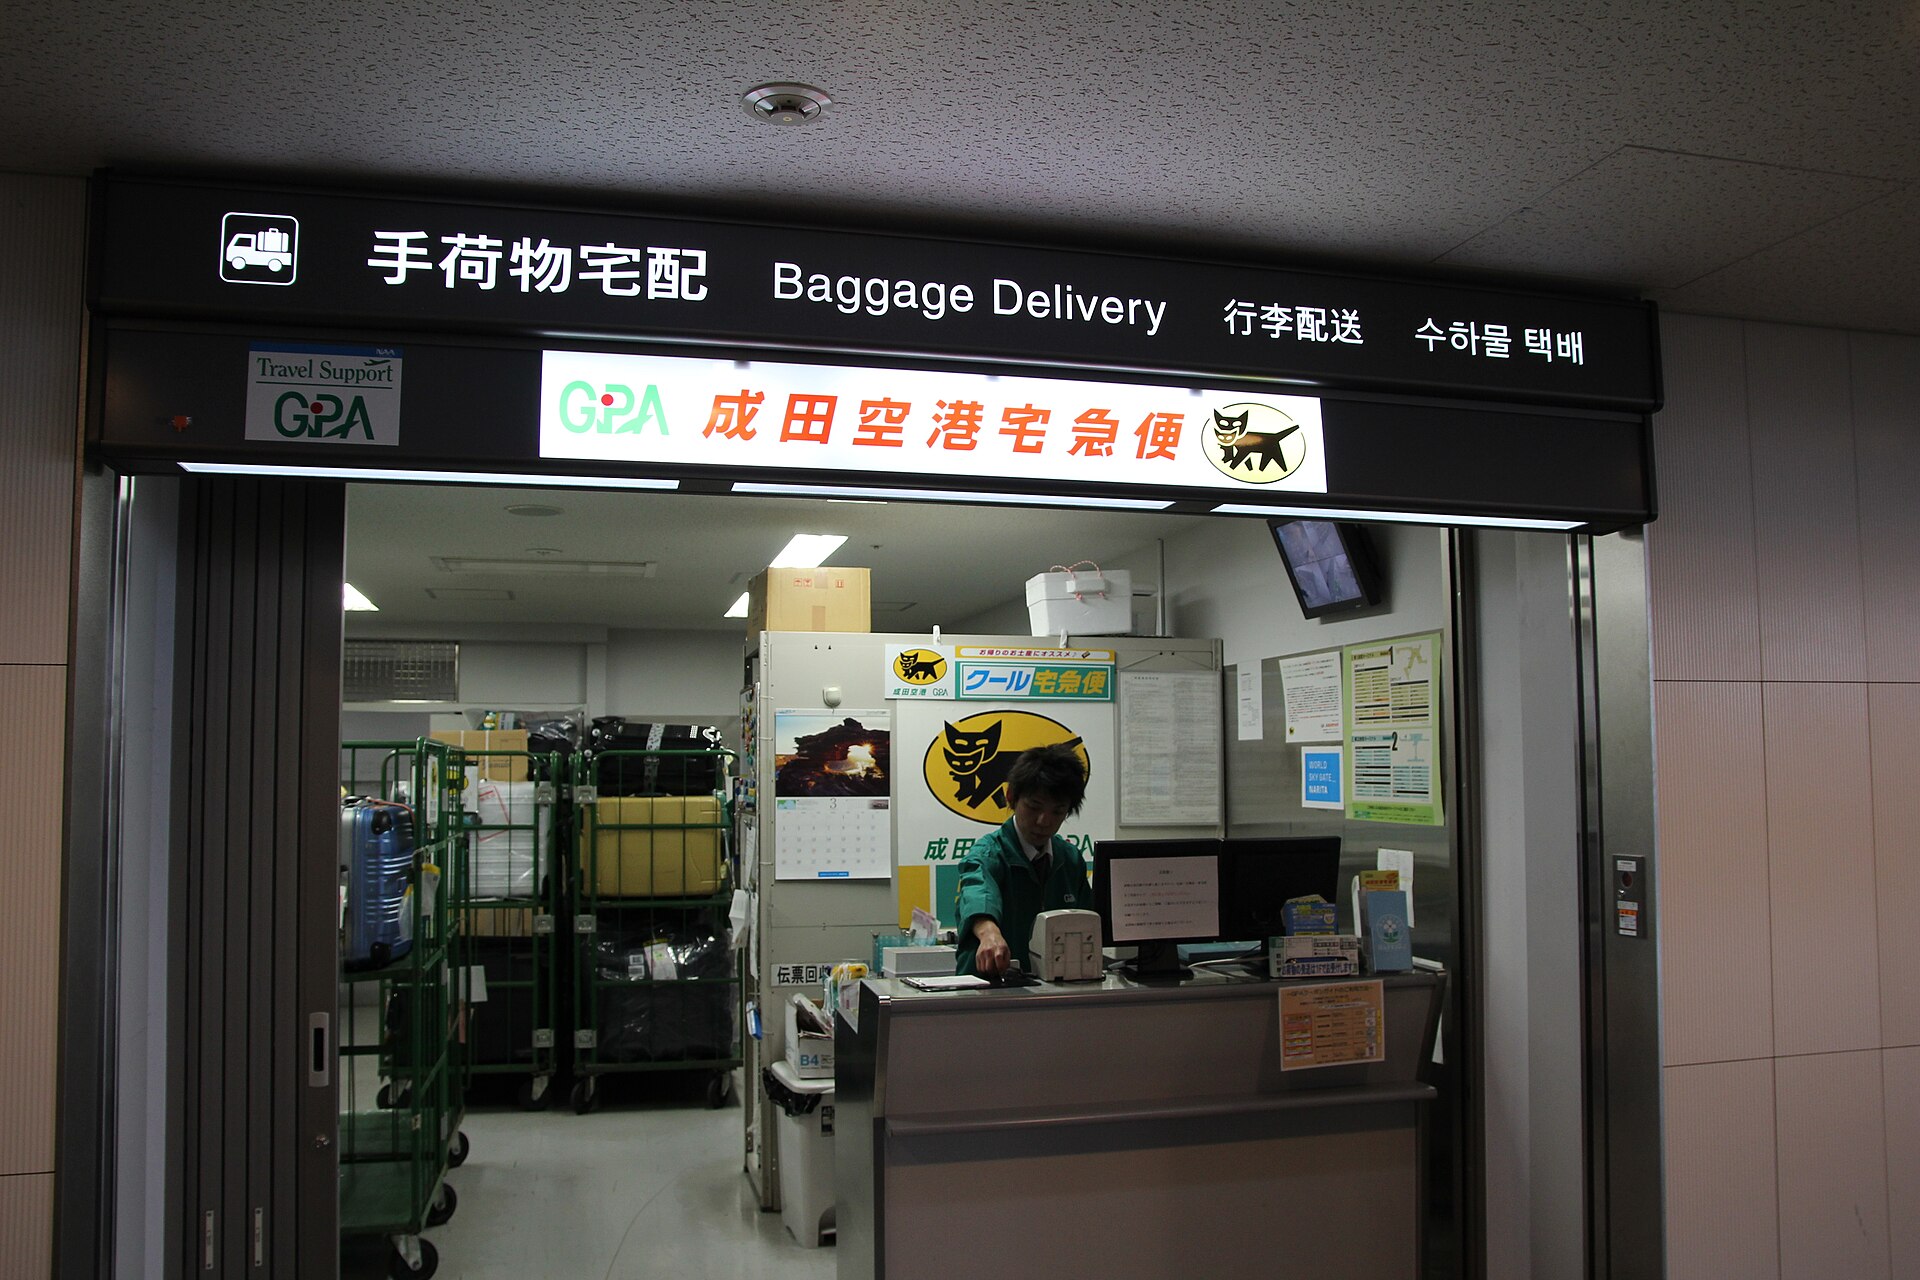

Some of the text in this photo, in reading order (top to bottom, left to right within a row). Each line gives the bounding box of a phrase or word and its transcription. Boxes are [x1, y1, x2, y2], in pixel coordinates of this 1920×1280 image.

[368, 230, 708, 301] 手荷物宅配
[774, 262, 1167, 336] Baggage Delivery
[1224, 298, 1364, 345] 行李配送
[1415, 317, 1584, 366] 수하물 택배
[256, 357, 394, 385] Travel Support
[274, 391, 375, 440] GPA
[559, 379, 670, 436] GPA
[702, 388, 1185, 462] 成田空港宅急便
[965, 669, 1107, 694] クール宅急便
[1392, 731, 1398, 751] 2
[1309, 761, 1327, 769] WORLD
[829, 798, 837, 809] 3
[1309, 785, 1328, 794] NARITA
[800, 1054, 819, 1066] B4
